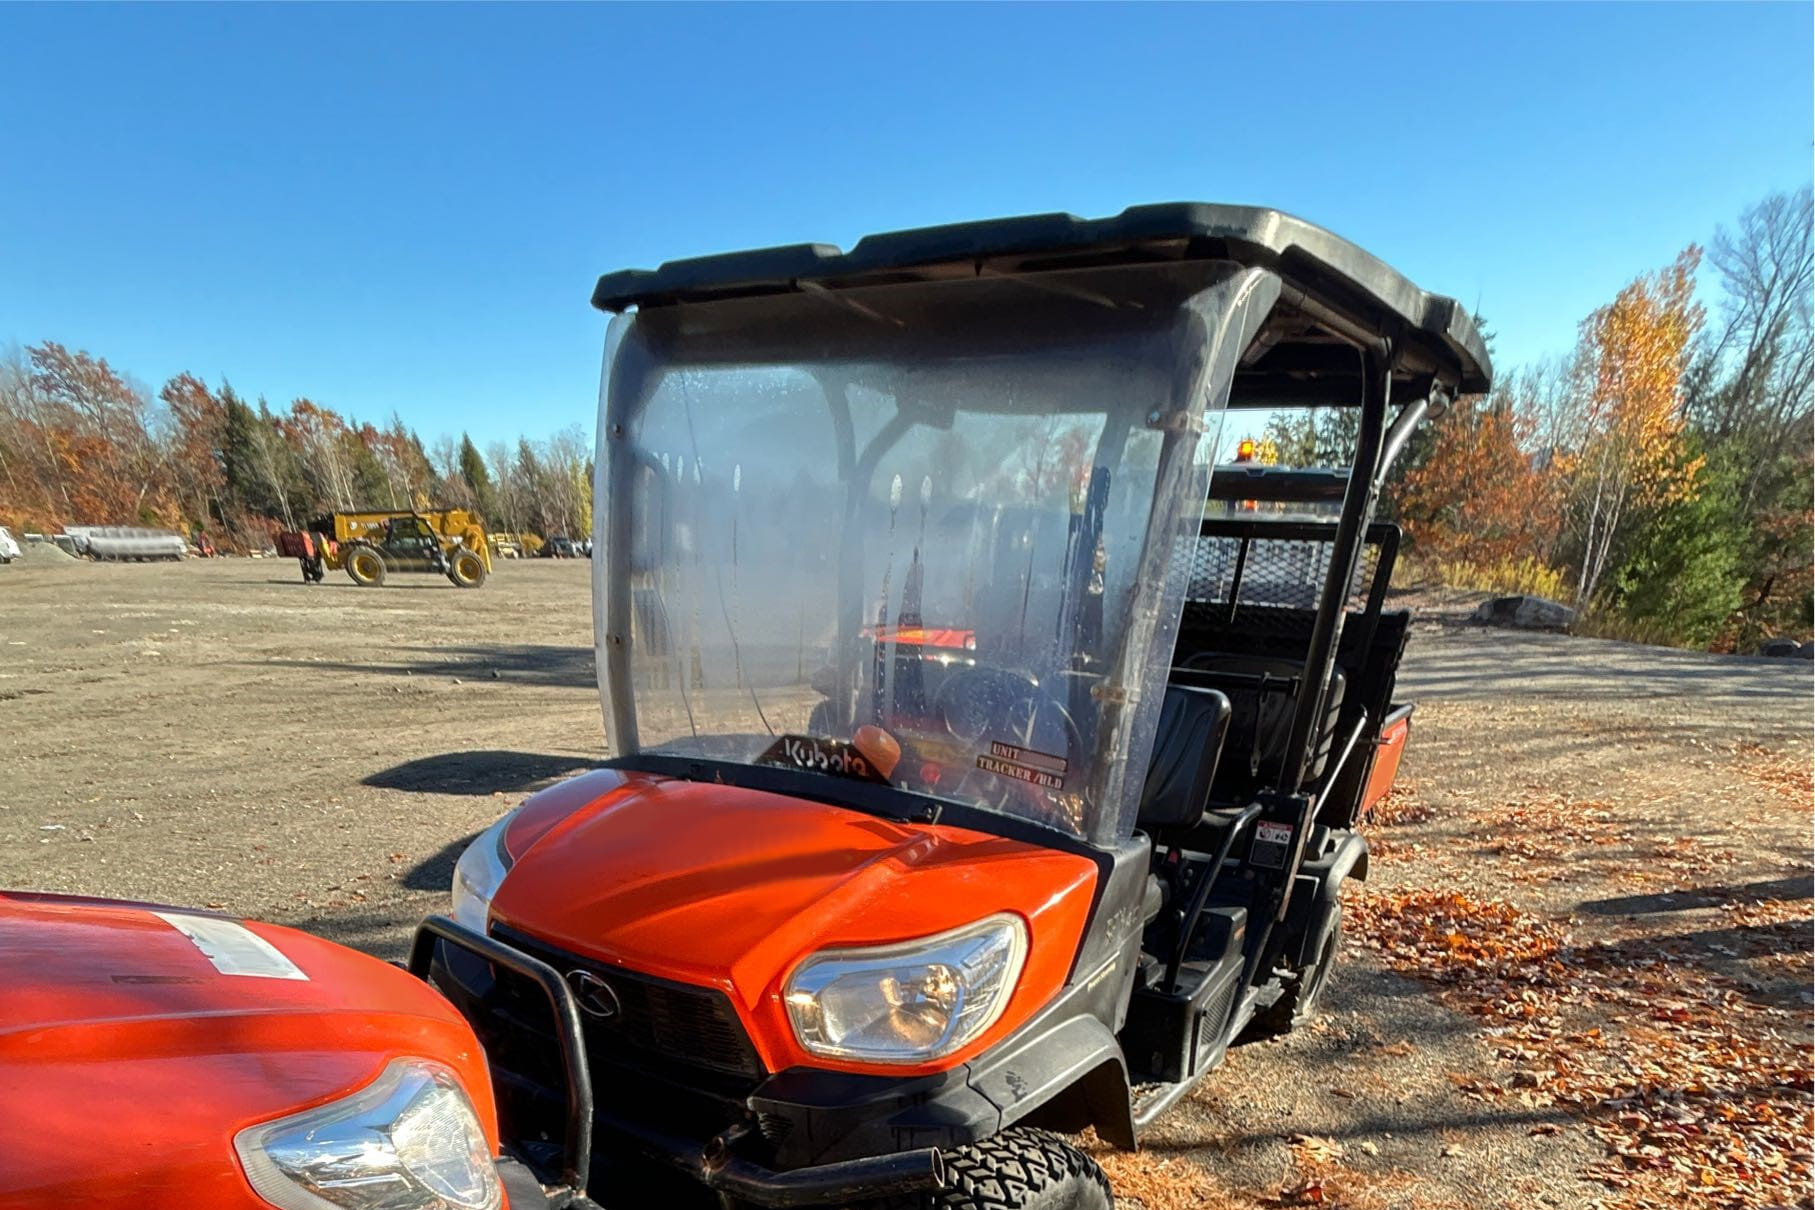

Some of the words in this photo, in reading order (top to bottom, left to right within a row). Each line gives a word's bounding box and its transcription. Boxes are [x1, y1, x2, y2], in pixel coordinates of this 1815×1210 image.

[784, 737, 868, 777] Kubota
[992, 743, 1020, 760] UNIT
[978, 757, 1031, 782] TRACKER
